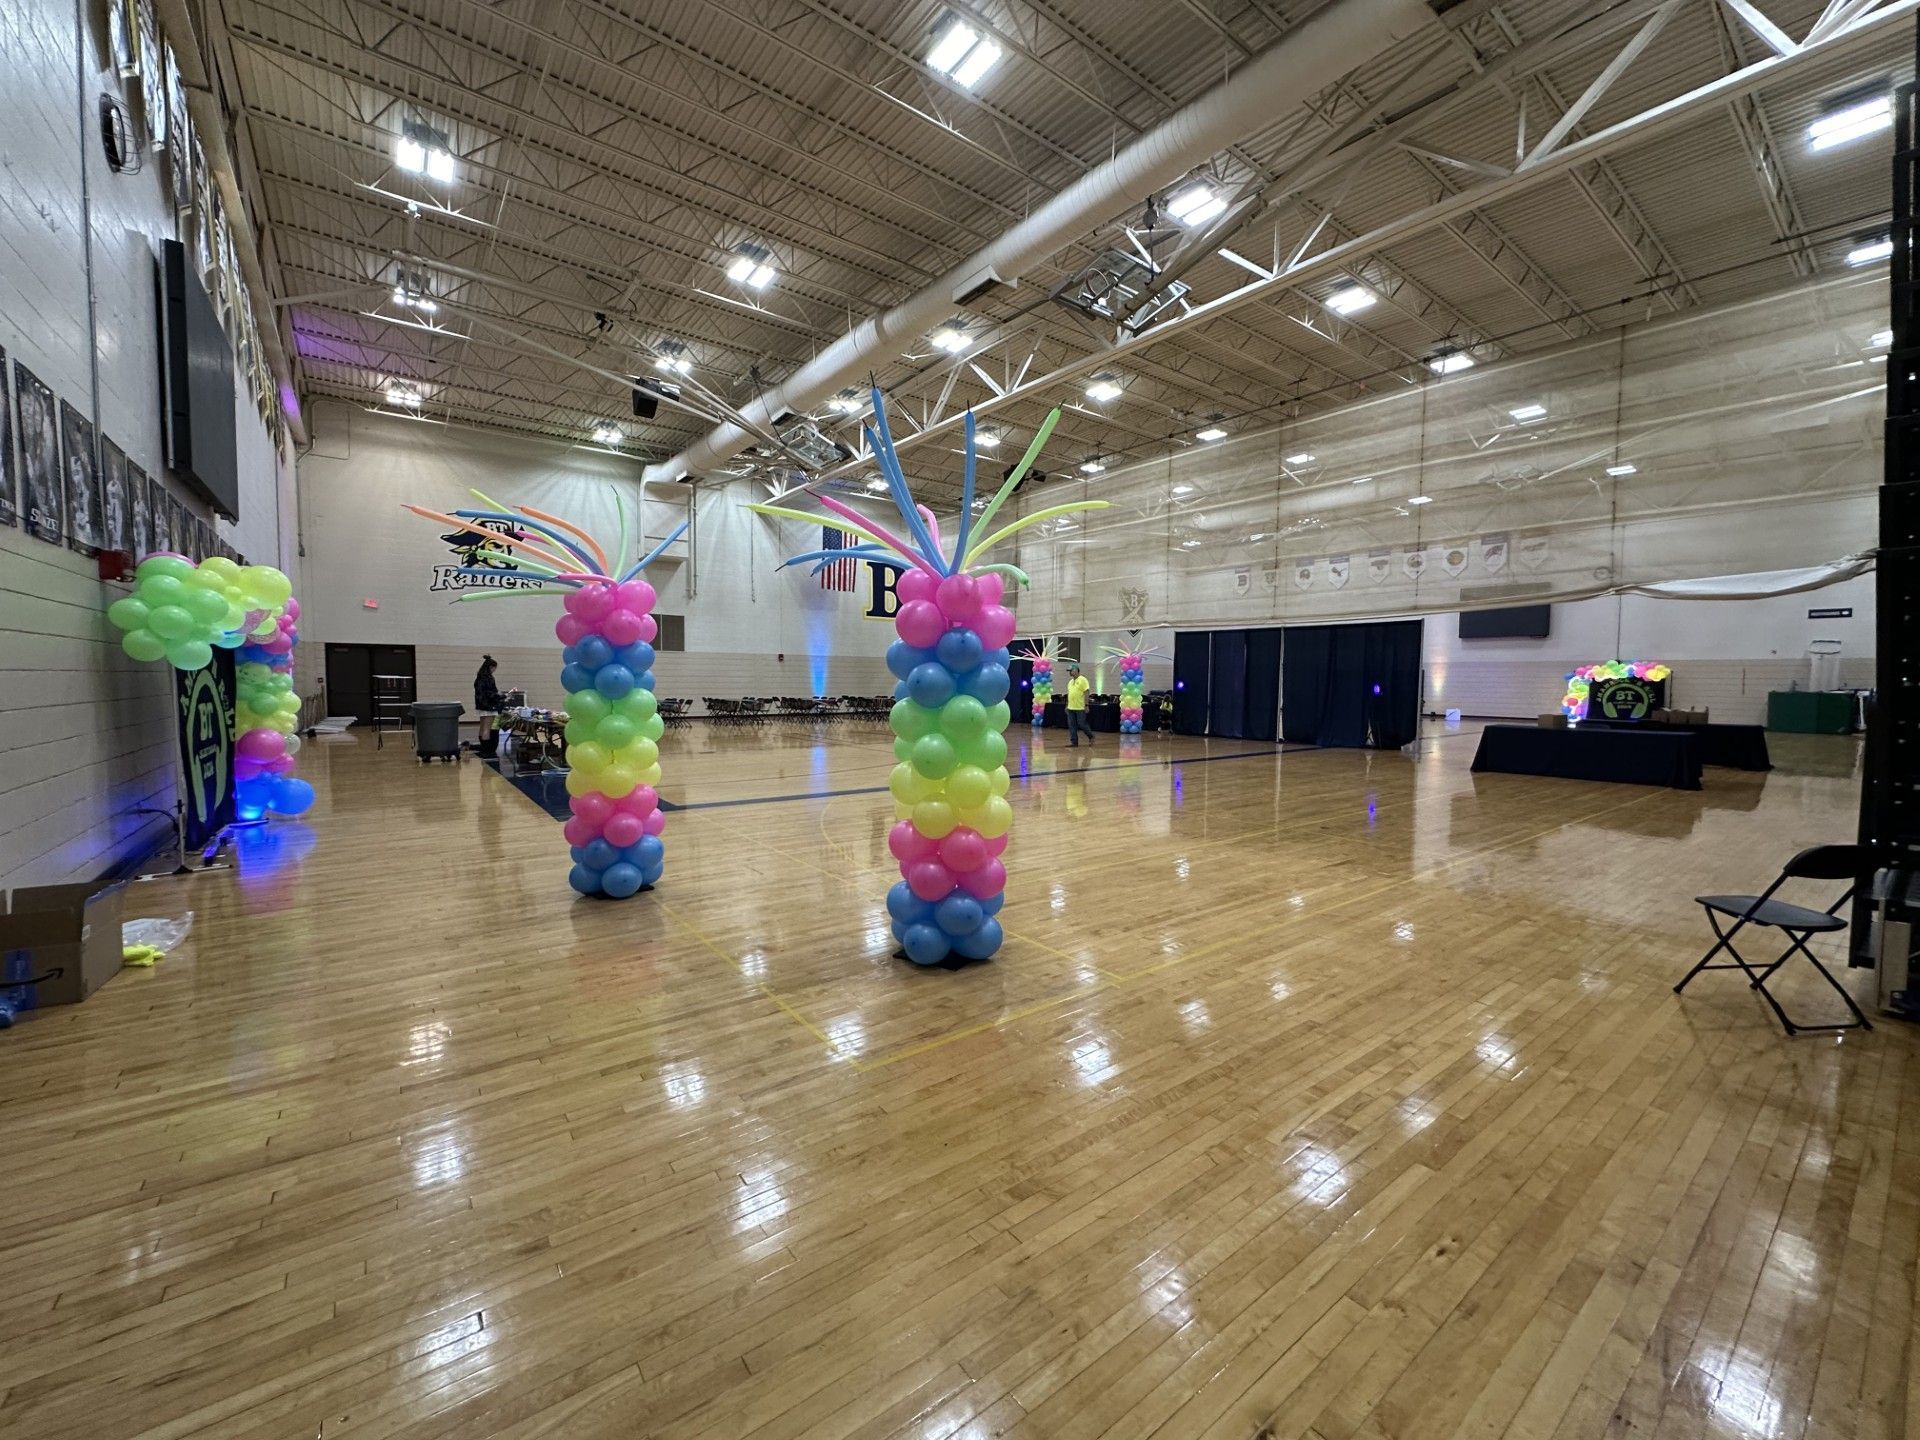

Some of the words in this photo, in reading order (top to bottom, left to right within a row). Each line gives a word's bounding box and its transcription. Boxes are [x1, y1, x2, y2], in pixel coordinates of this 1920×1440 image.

[430, 565, 544, 591] Raiders
[864, 560, 906, 621] B
[1615, 690, 1636, 700] BT
[198, 702, 215, 741] BT
